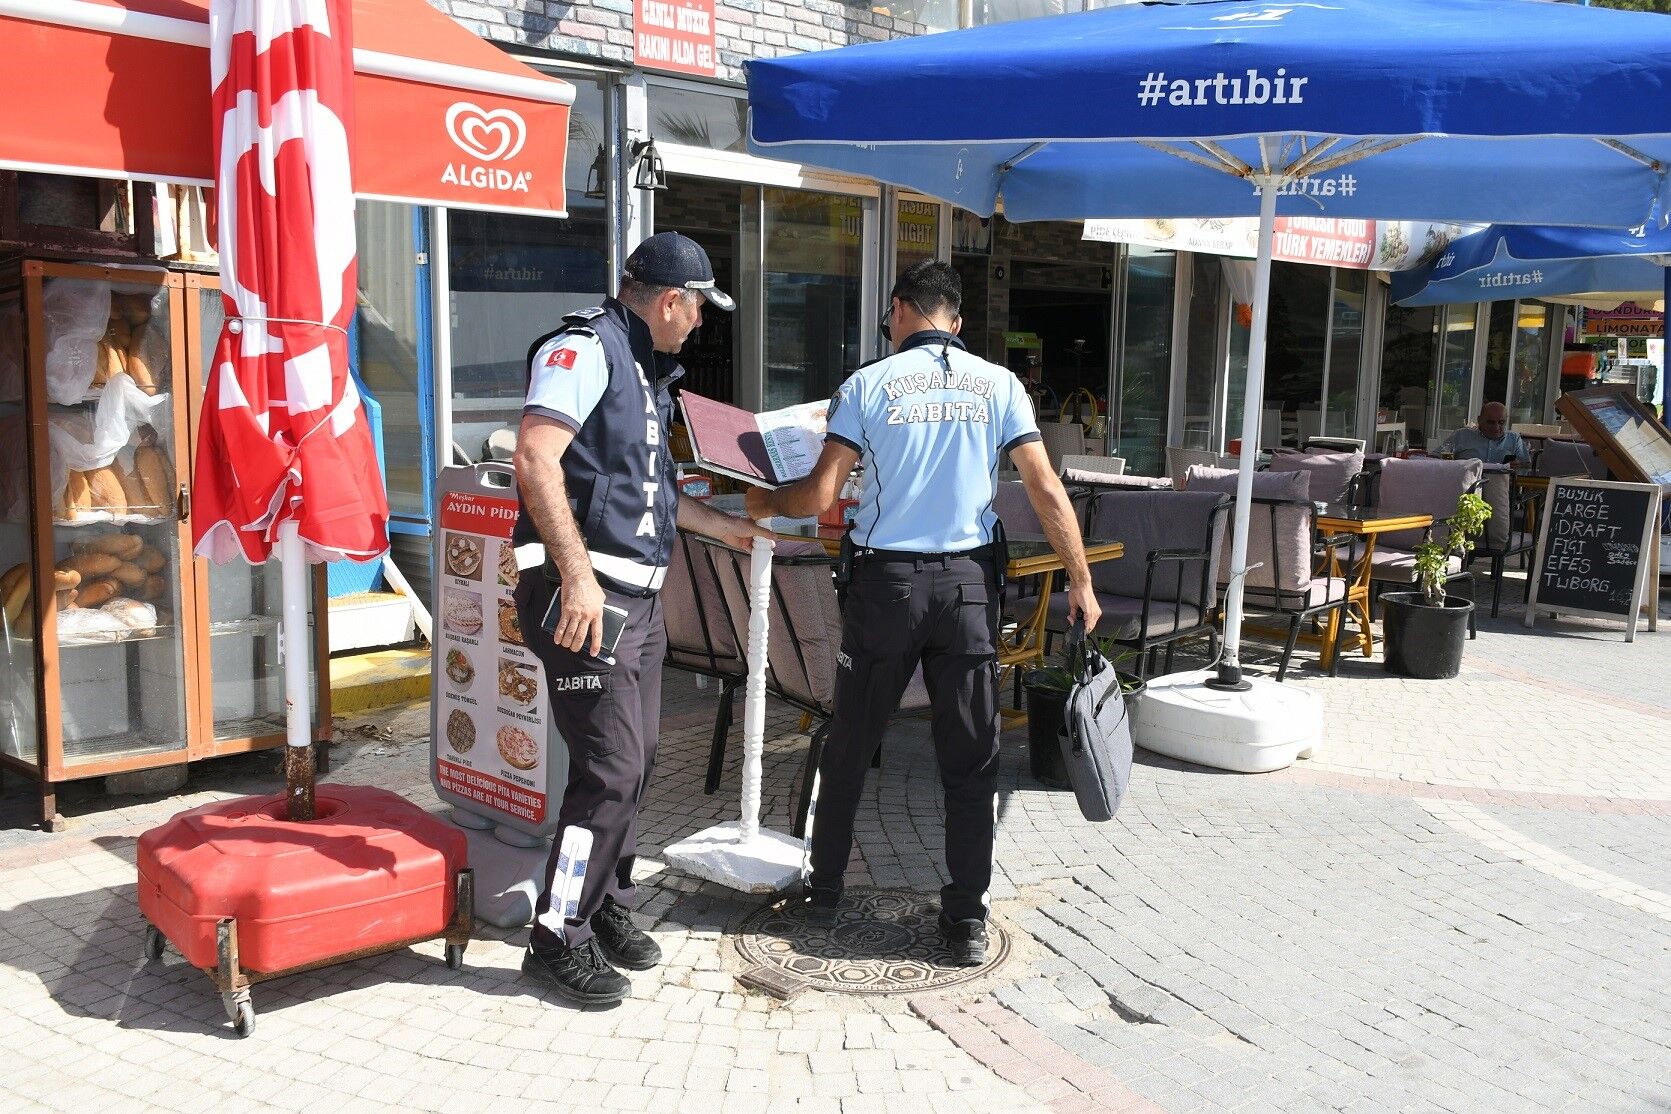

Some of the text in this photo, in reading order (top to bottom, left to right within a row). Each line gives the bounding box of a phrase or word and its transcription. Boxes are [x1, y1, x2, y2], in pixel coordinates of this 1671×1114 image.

[642, 0, 675, 29] CANLI
[672, 39, 696, 66] ALDA
[697, 43, 715, 69] GEL
[882, 370, 995, 402] KUŞADASI
[886, 402, 990, 426] ZABITA
[446, 501, 486, 516] AYDIN
[1553, 502, 1610, 520] LARGE
[1558, 519, 1622, 540] DRAFT
[1547, 555, 1592, 574] EFES
[1543, 572, 1610, 593] TUBORG
[556, 675, 602, 691] ZABITA
[449, 768, 465, 781] MOST
[472, 789, 484, 801] ARE
[485, 794, 492, 803] AT
[493, 795, 508, 810] YOUR
